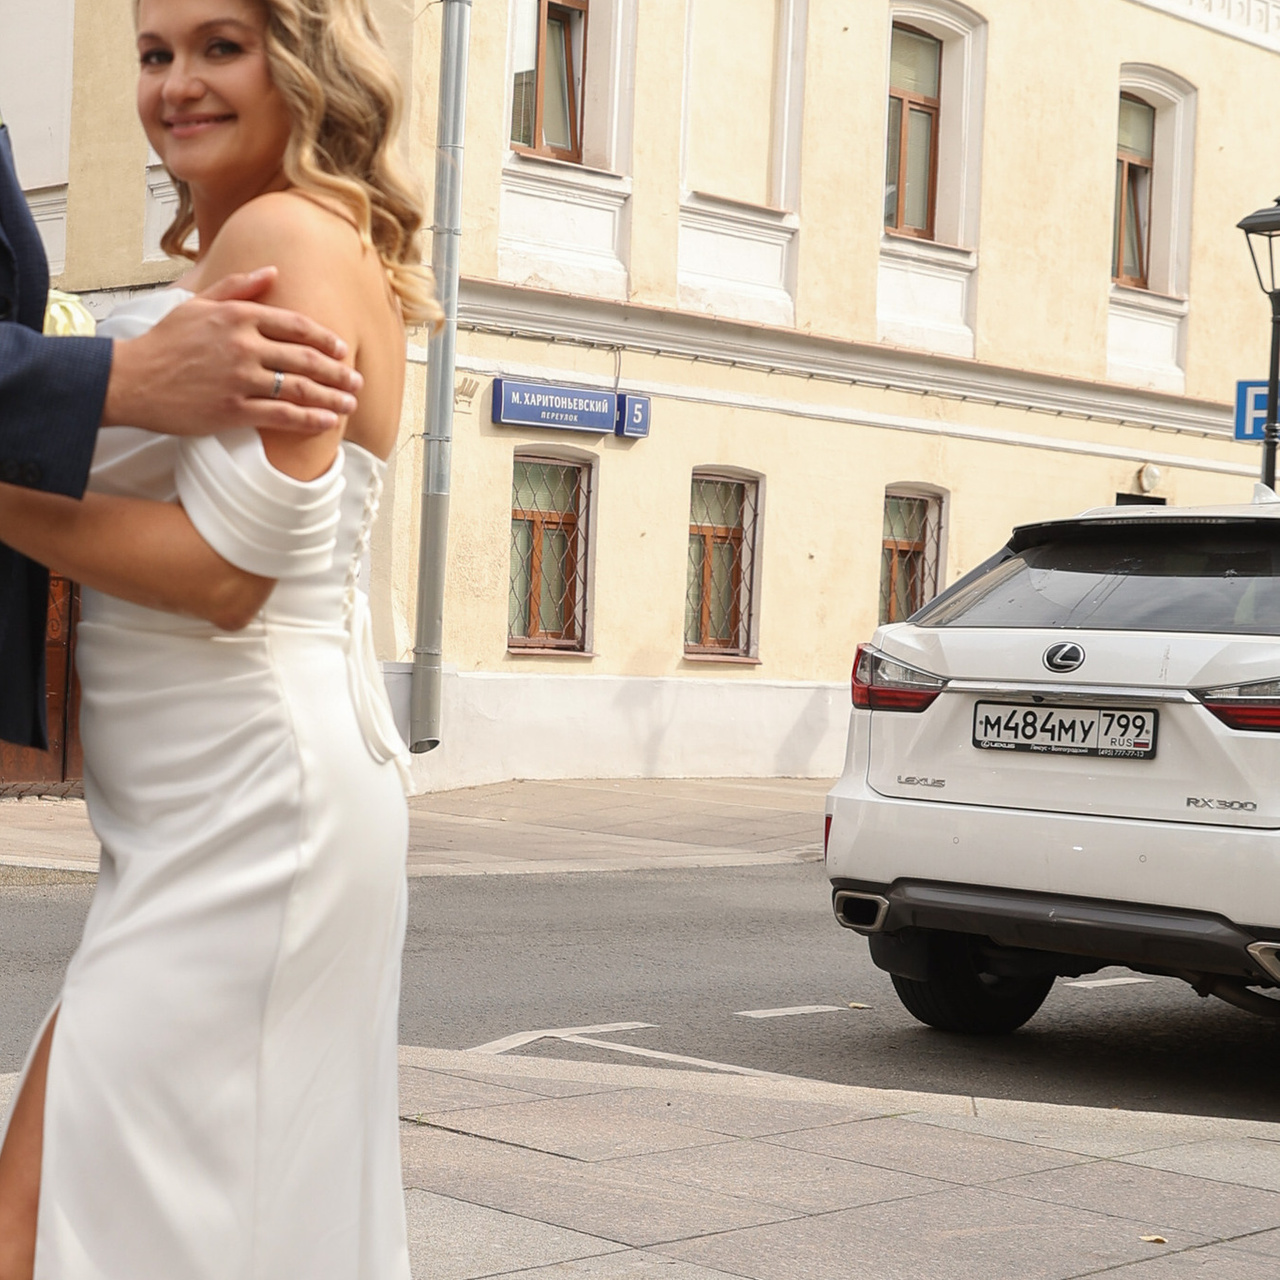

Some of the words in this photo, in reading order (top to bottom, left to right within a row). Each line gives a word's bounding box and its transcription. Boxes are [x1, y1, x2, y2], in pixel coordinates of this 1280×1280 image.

[511, 391, 523, 404] М.
[523, 392, 609, 414] ХАРИТОНЬЕВСКИЙ
[540, 411, 578, 422] ПЕРЕУЛОК
[633, 403, 643, 423] 5
[1102, 713, 1146, 738] 799
[1110, 737, 1133, 748] RUS
[897, 775, 946, 788] LEXUS
[1186, 797, 1214, 809] RX
[1216, 799, 1257, 812] 300
